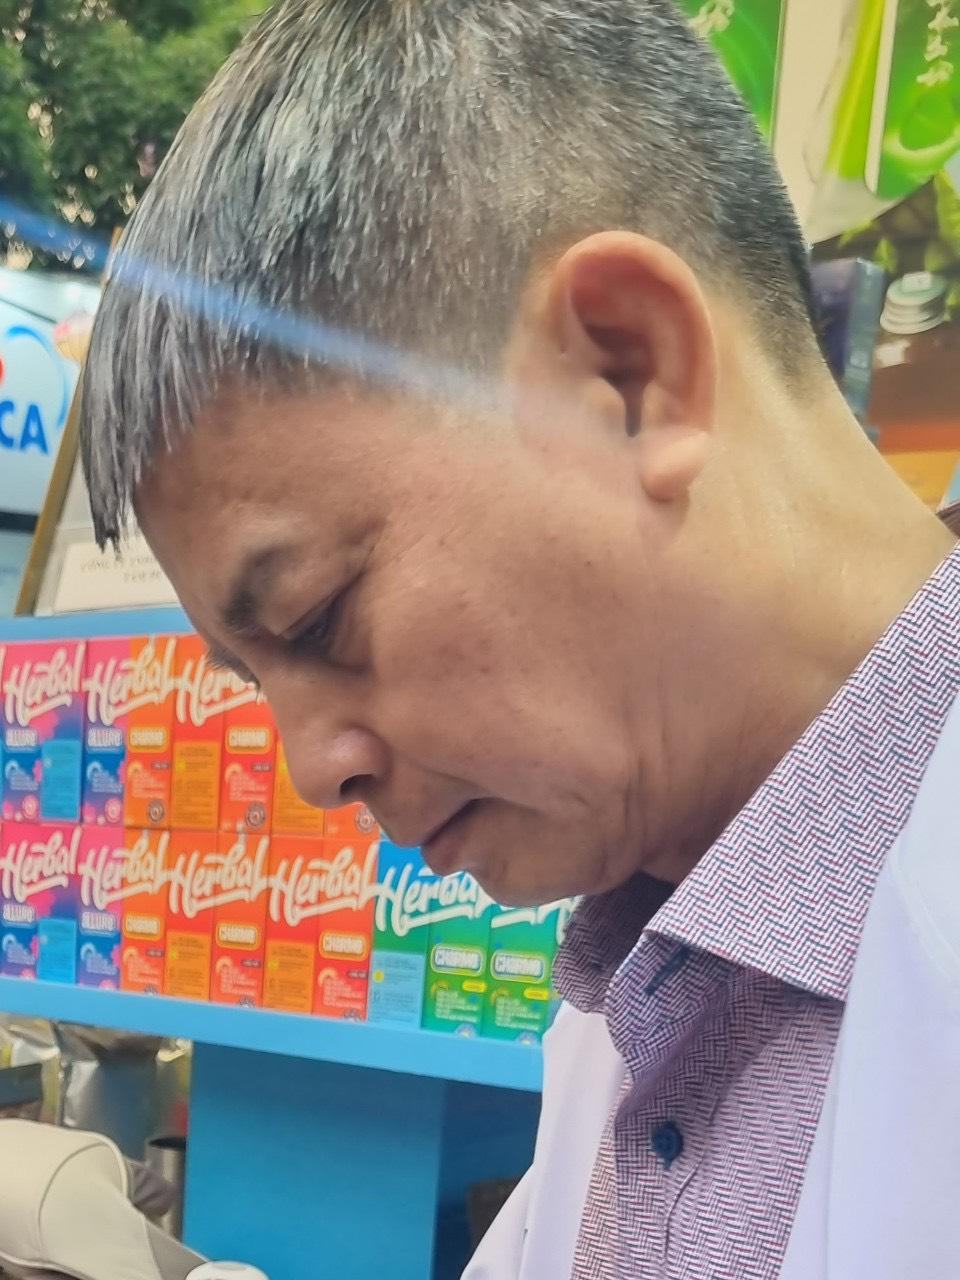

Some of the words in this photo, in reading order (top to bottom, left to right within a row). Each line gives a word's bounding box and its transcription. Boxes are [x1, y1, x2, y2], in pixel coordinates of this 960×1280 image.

[3, 639, 88, 727] Herbal
[82, 634, 178, 726] Herbal
[79, 829, 171, 911] Herbal
[166, 828, 270, 919] Herbal
[267, 839, 380, 928] Herbal
